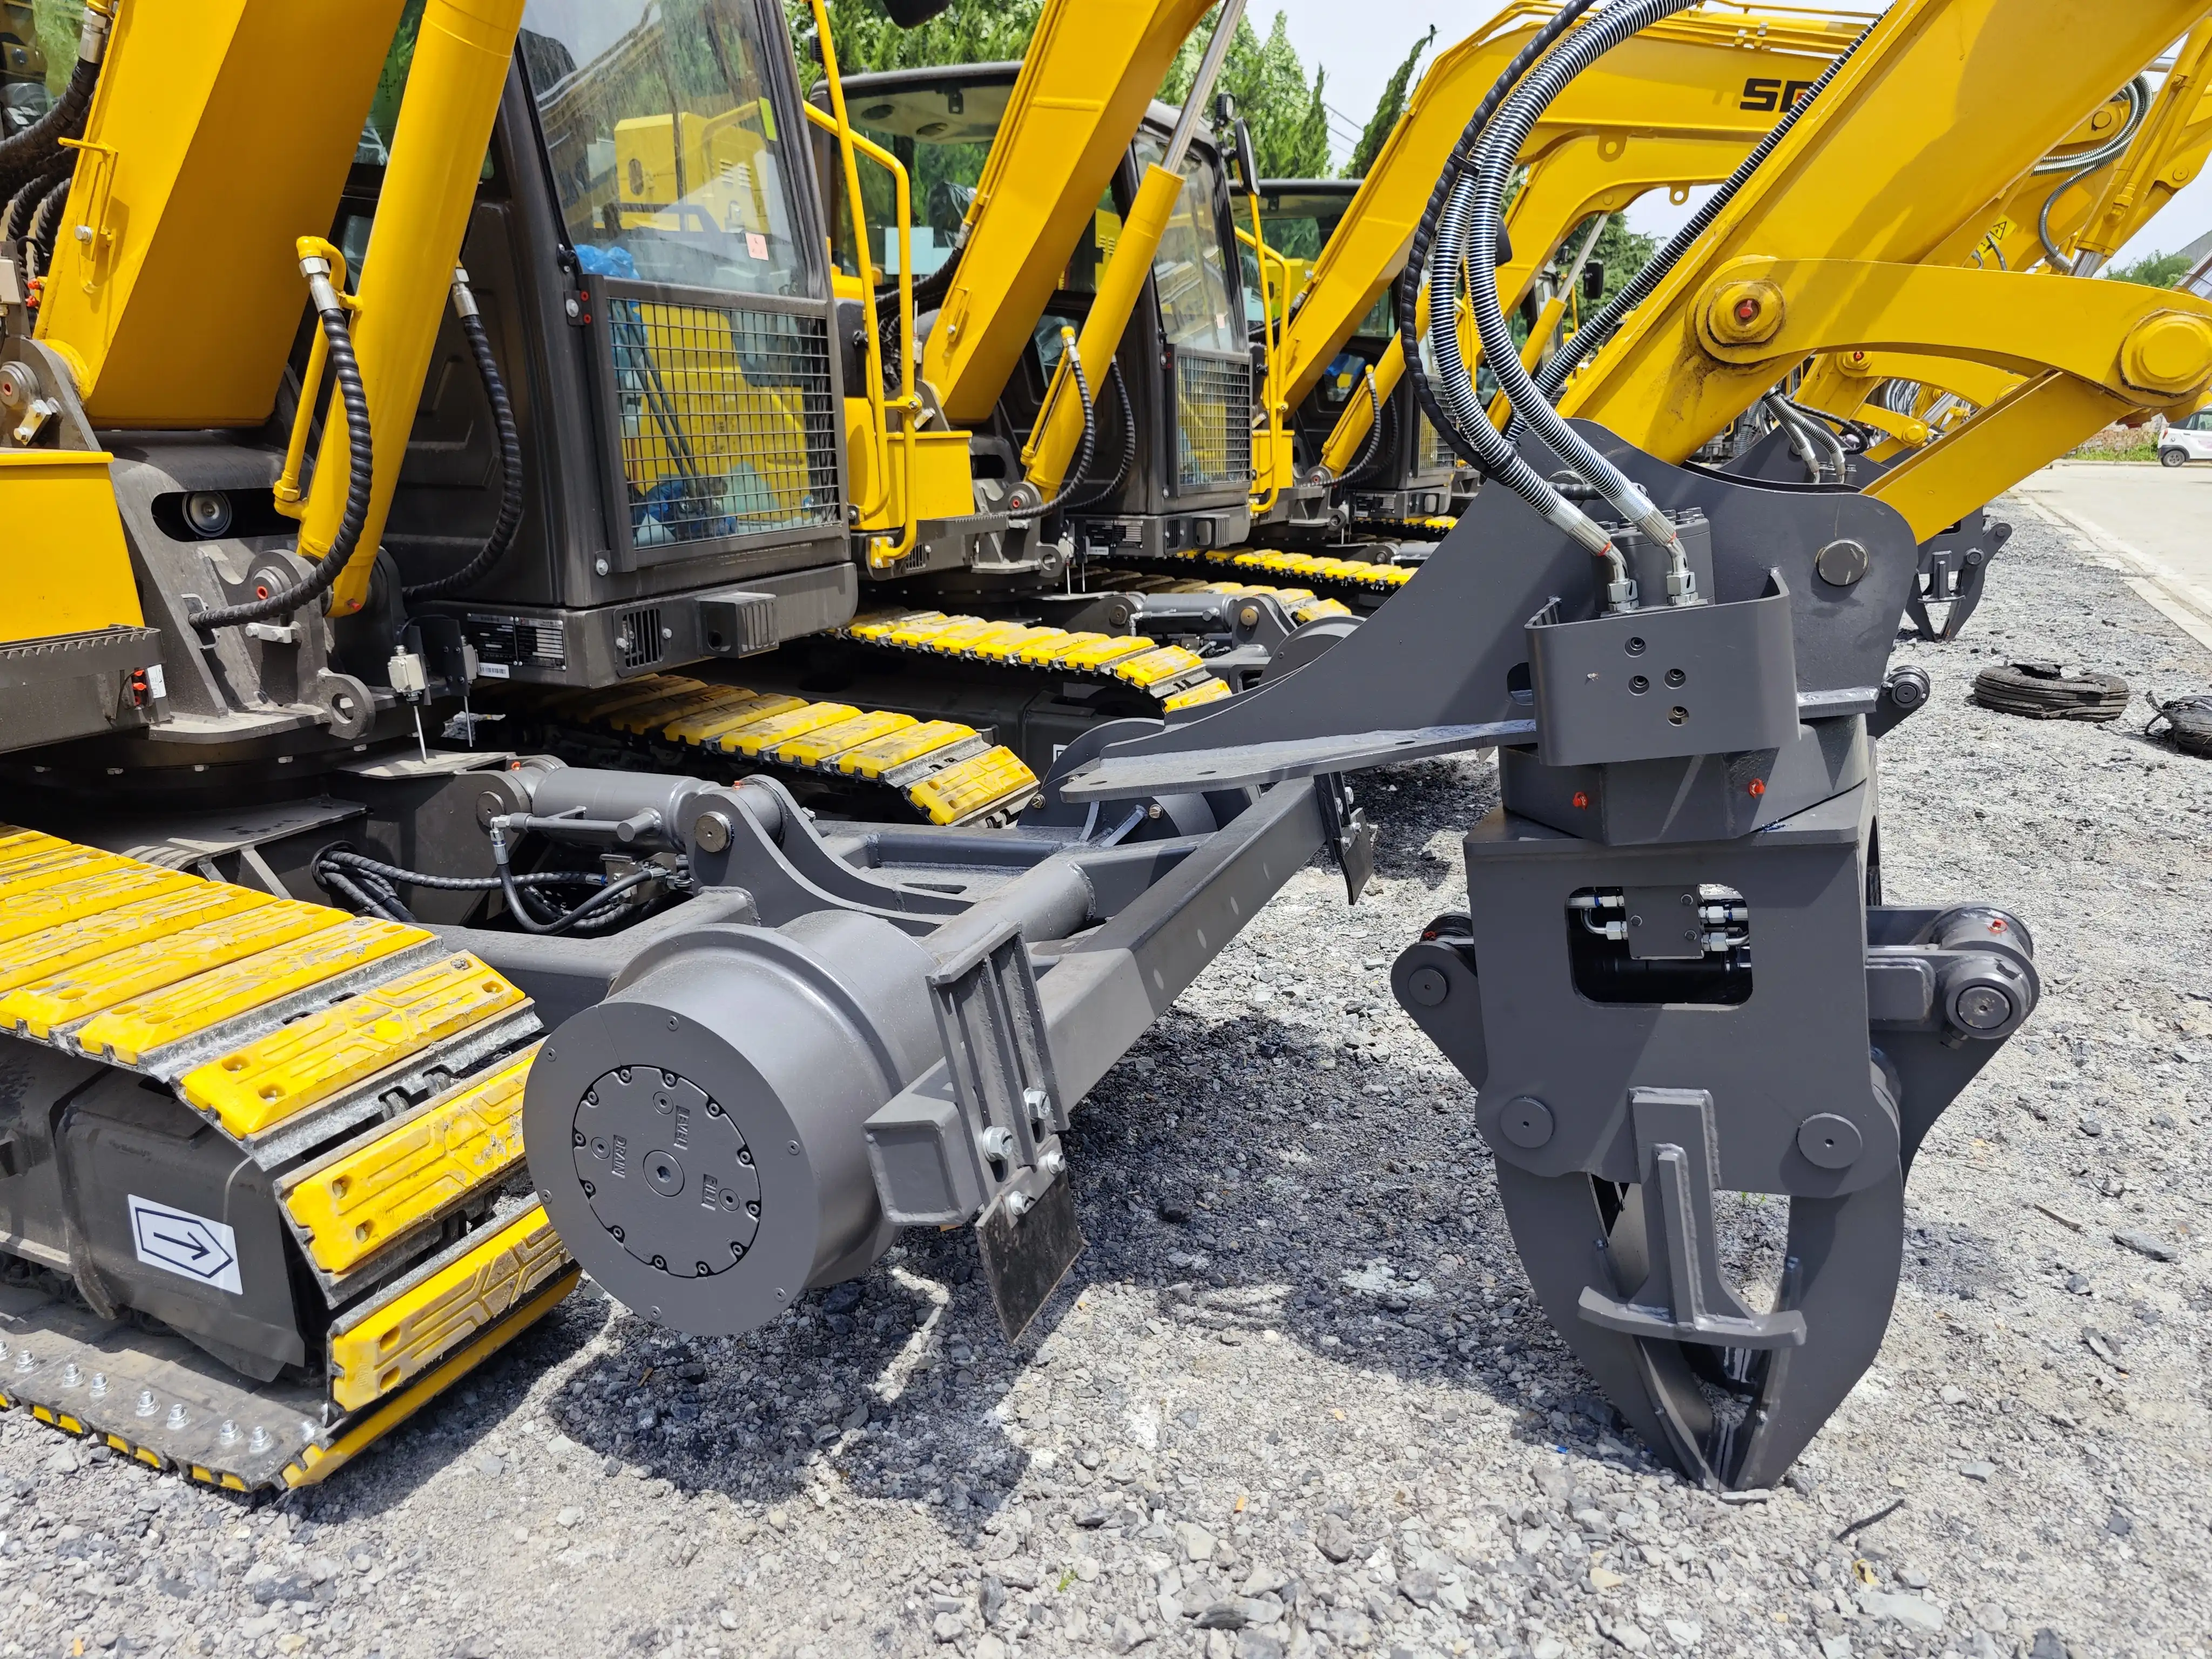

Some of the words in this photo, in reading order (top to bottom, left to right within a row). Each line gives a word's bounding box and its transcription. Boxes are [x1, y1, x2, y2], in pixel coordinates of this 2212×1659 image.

[675, 1105, 690, 1149] LEVEL
[613, 1135, 626, 1177] DRAIN
[703, 1175, 717, 1210] FILL
